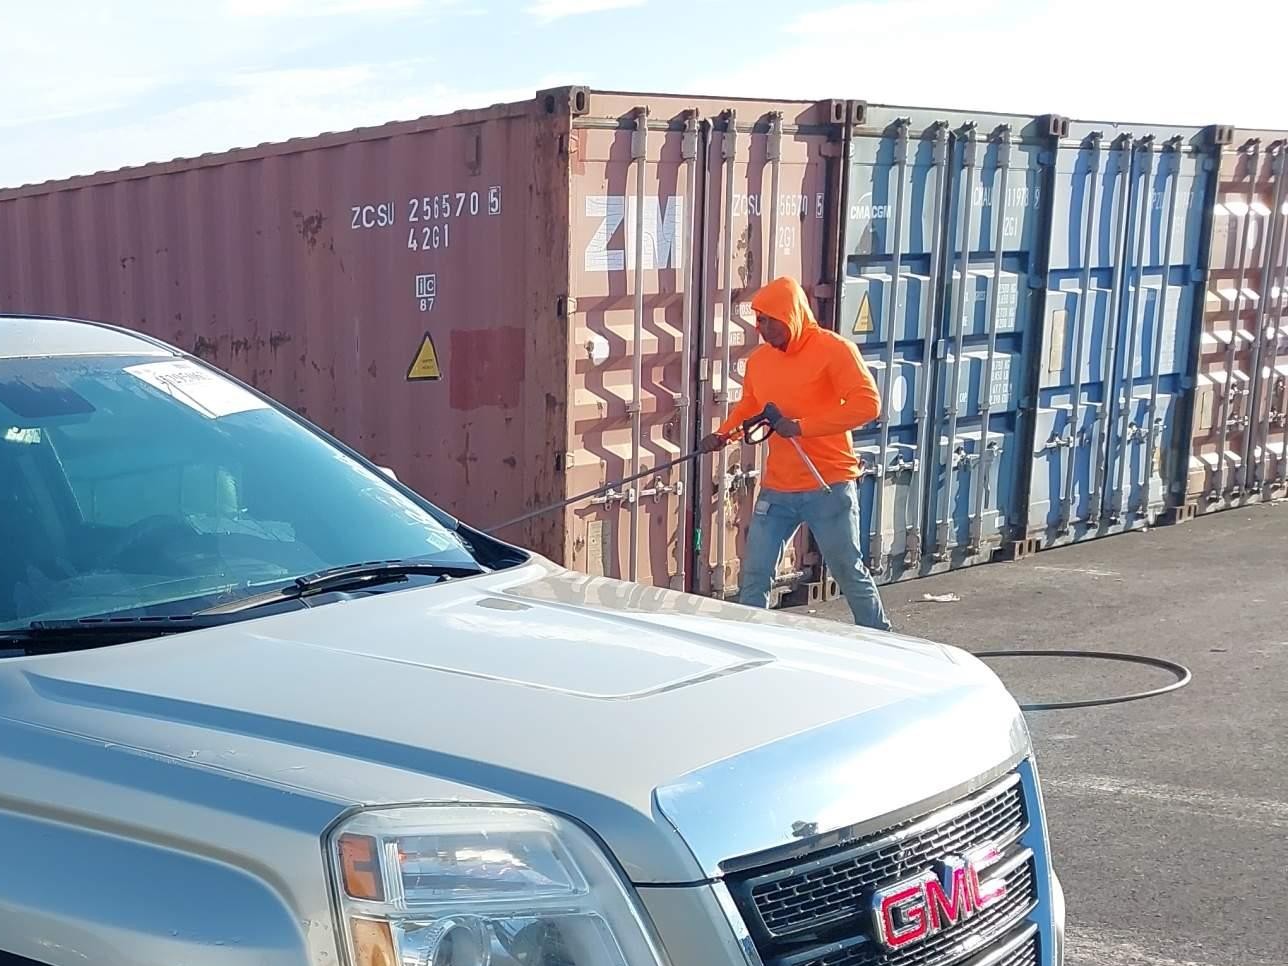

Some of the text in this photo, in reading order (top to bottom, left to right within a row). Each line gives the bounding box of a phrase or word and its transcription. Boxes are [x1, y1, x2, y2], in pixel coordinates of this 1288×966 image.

[351, 186, 500, 229] ZCSU 256570 5
[779, 194, 808, 216] 56570
[850, 205, 892, 219] CMA CGM
[408, 223, 449, 251] 42G1
[778, 226, 795, 248] 2G1
[1004, 217, 1017, 236] 2G1
[419, 298, 434, 312] 87
[873, 840, 1007, 949] GMC
